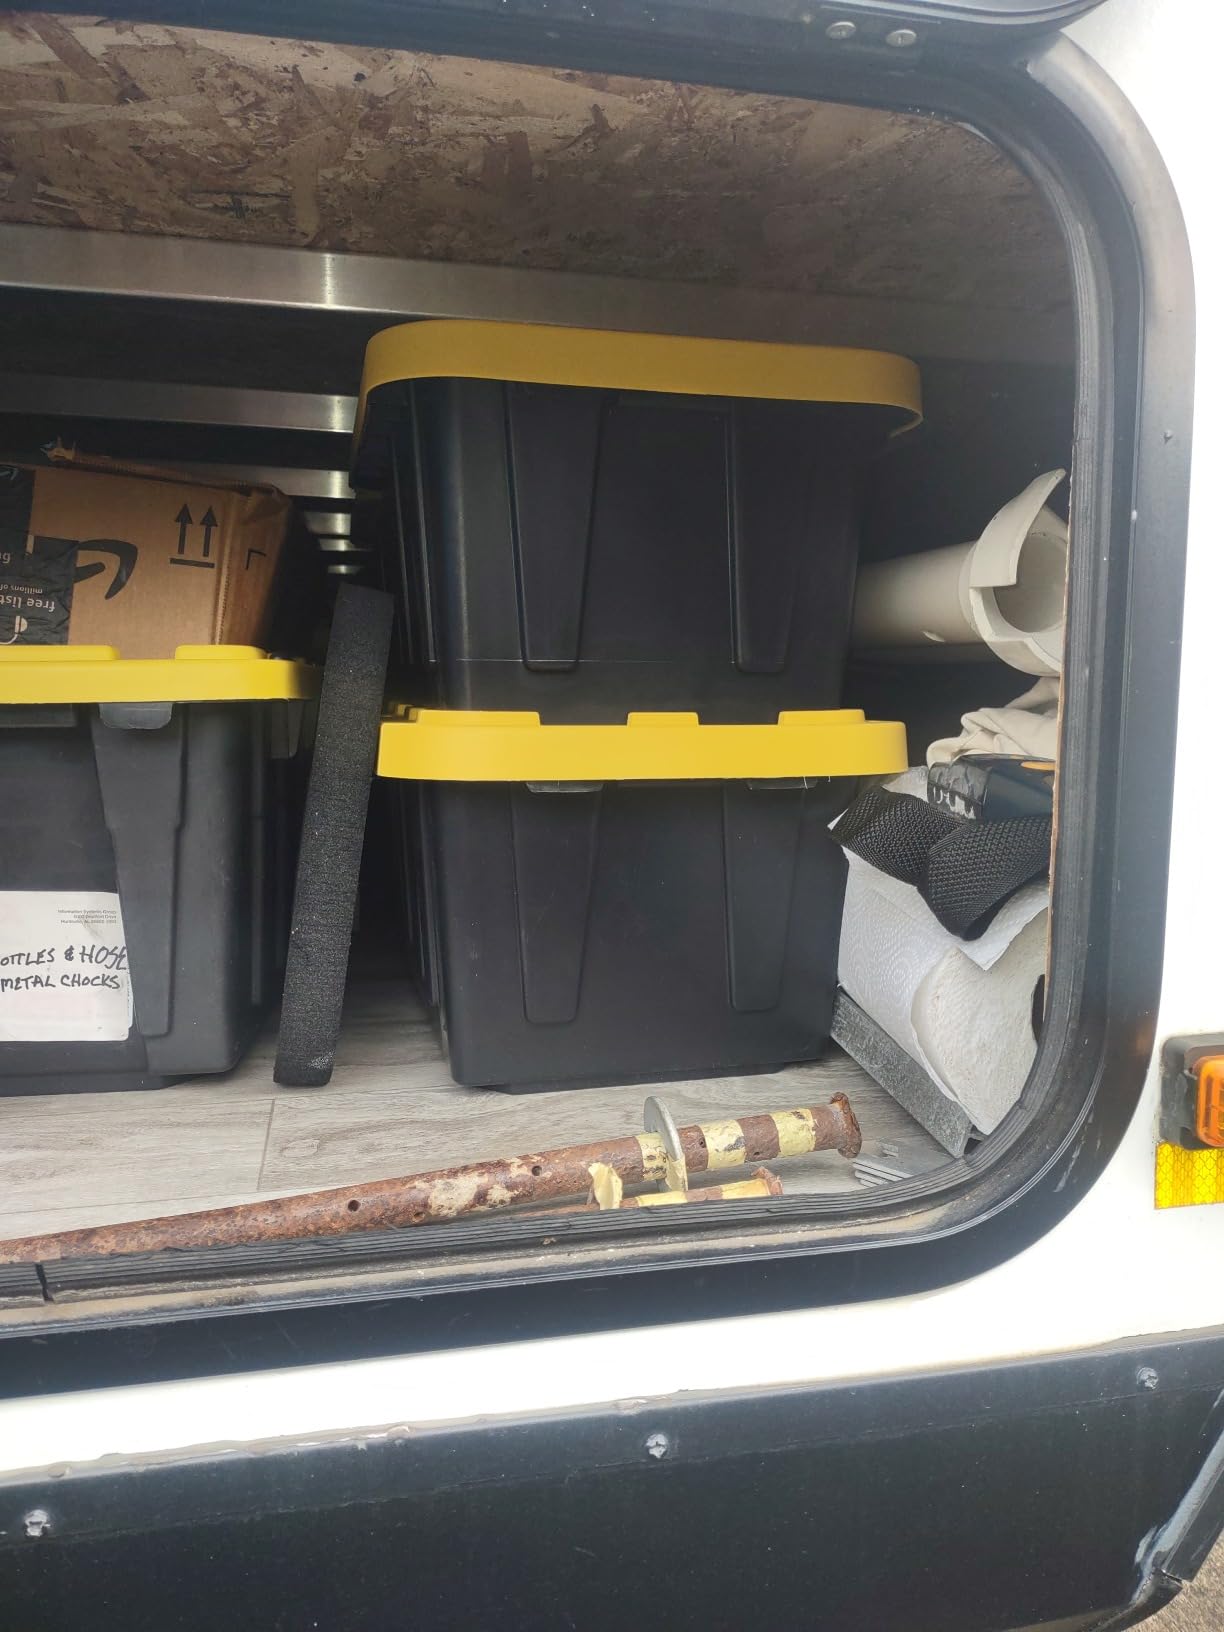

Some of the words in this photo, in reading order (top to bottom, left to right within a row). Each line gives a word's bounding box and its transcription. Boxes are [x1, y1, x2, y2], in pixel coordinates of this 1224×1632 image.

[10, 585, 43, 594] millions
[27, 598, 56, 613] free
[64, 945, 75, 961] &
[0, 973, 56, 993] METAL
[60, 973, 121, 990] CHOCKS
